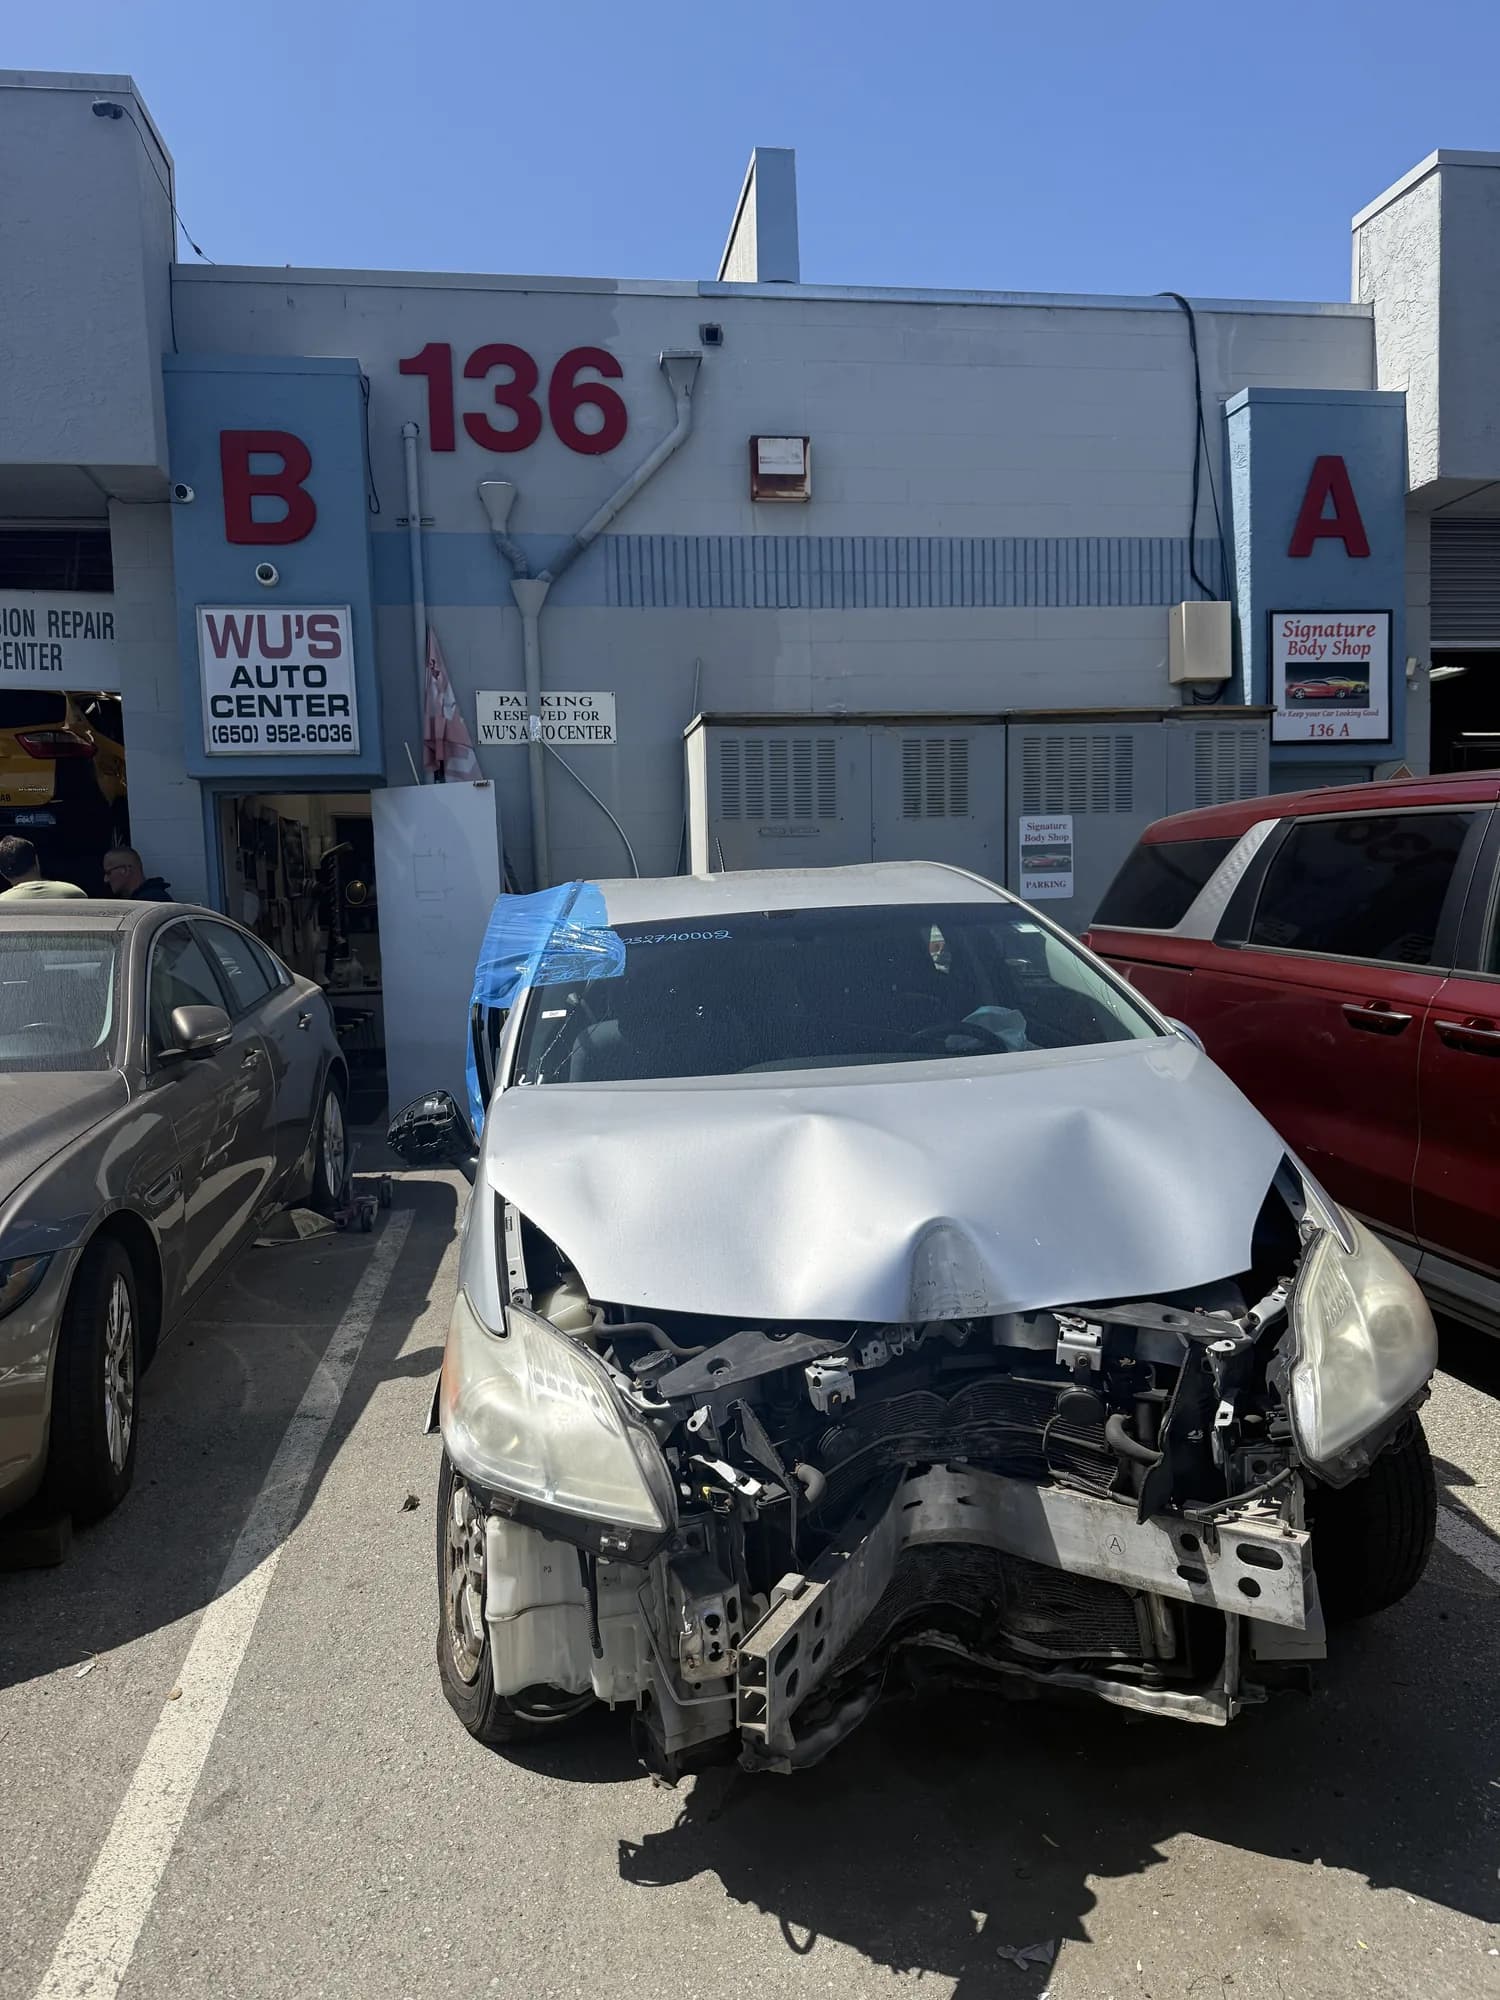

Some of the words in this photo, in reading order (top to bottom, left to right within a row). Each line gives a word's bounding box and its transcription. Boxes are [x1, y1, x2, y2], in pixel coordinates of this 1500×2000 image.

[399, 342, 628, 455] 136
[220, 430, 317, 545] B
[1287, 455, 1370, 558] A
[0, 608, 36, 638] ION
[47, 609, 115, 640] REPAIR
[1282, 620, 1376, 642] Signature
[205, 614, 342, 659] WU'S
[1288, 640, 1327, 660] Body
[1332, 639, 1371, 660] Shop
[230, 665, 327, 688] AUTO
[210, 694, 350, 718] CENTER
[499, 696, 593, 707] PAKING
[494, 711, 567, 721] RESEVED
[573, 711, 599, 721] FOR
[1288, 710, 1304, 719] Keep
[1304, 710, 1321, 719] your
[1322, 709, 1334, 717] Car
[1335, 709, 1361, 718] Looking
[1362, 709, 1379, 717] Good
[212, 724, 259, 743] (650)
[482, 725, 517, 740] WU'S
[557, 725, 612, 740] CENTER
[1308, 724, 1334, 737] 136
[1339, 723, 1350, 737] A
[1027, 823, 1067, 831] Signature
[1024, 834, 1045, 844] Body
[1047, 833, 1070, 843] Shop
[1026, 881, 1066, 889] PARKING
